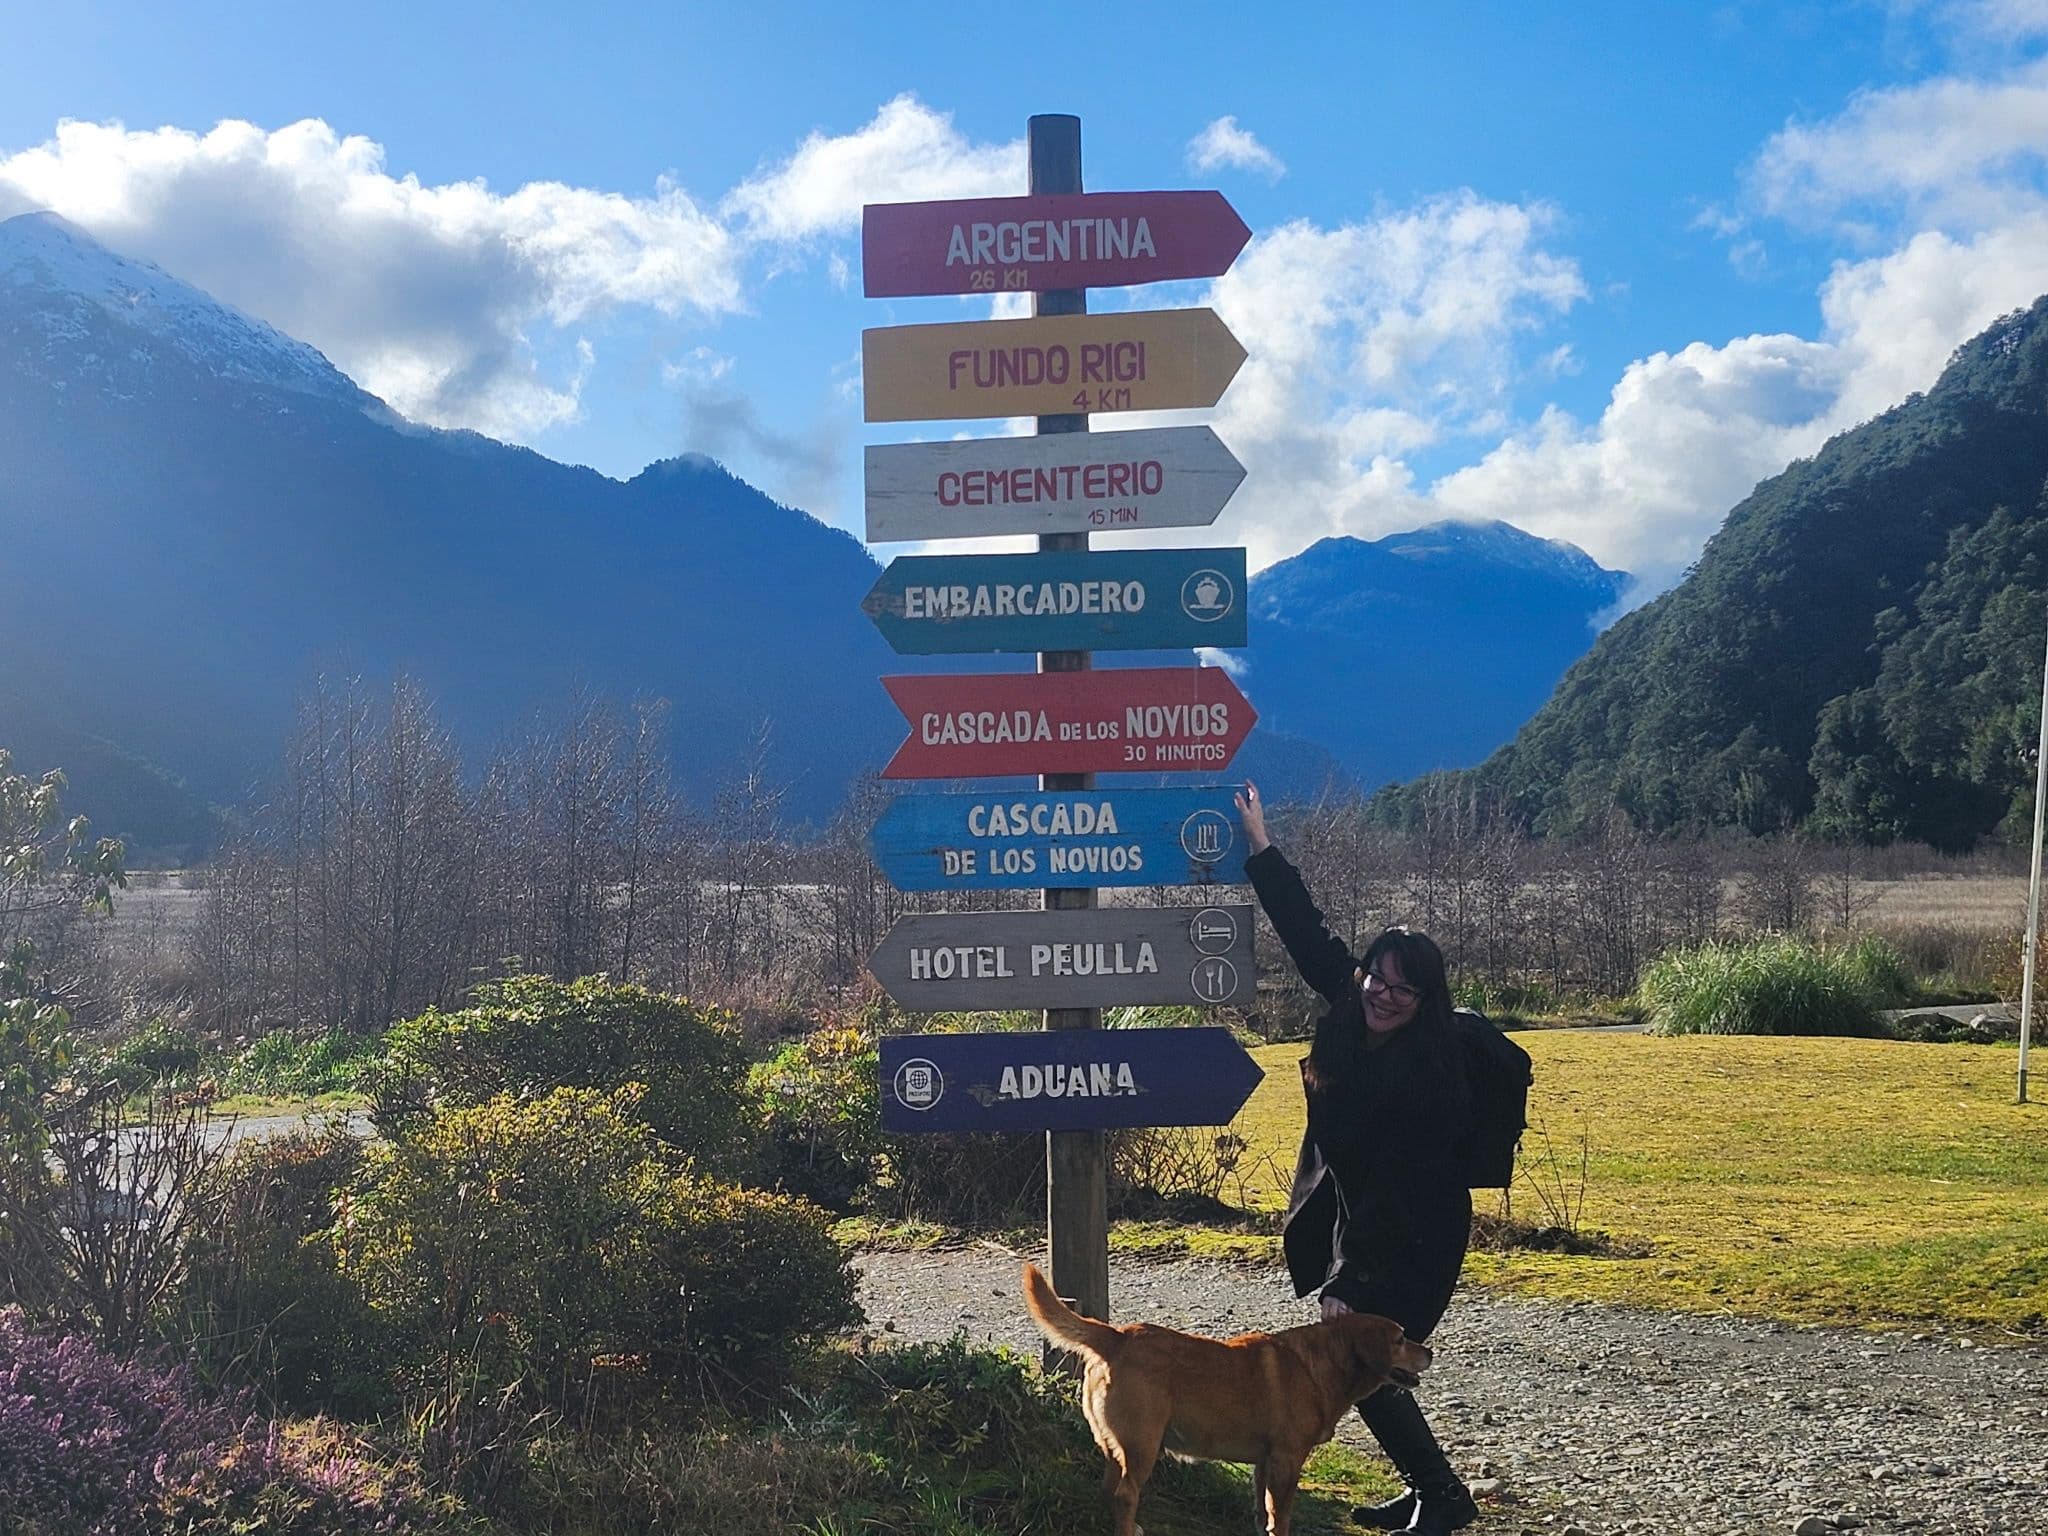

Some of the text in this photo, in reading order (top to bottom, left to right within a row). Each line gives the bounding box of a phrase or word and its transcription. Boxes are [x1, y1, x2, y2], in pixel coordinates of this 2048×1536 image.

[945, 217, 1156, 266] ARGENTINA
[970, 269, 1029, 290] 26 KM
[948, 341, 1146, 390] FUNDO RIGI
[1072, 388, 1131, 410] 4 KM
[938, 460, 1163, 507] CEMENTERIO
[1088, 506, 1138, 525] 15 MIN
[905, 580, 1146, 618] EMBARCADERO
[922, 703, 1229, 745] CASCADA DE LOS NOVIOS
[1124, 743, 1226, 761] 30 MINUTOS
[968, 802, 1119, 837] CASCADA
[945, 845, 1143, 876] DE LOS NOVIOS
[910, 942, 1159, 980] HOTEL PEULLA
[999, 1062, 1138, 1100] ADUANA
